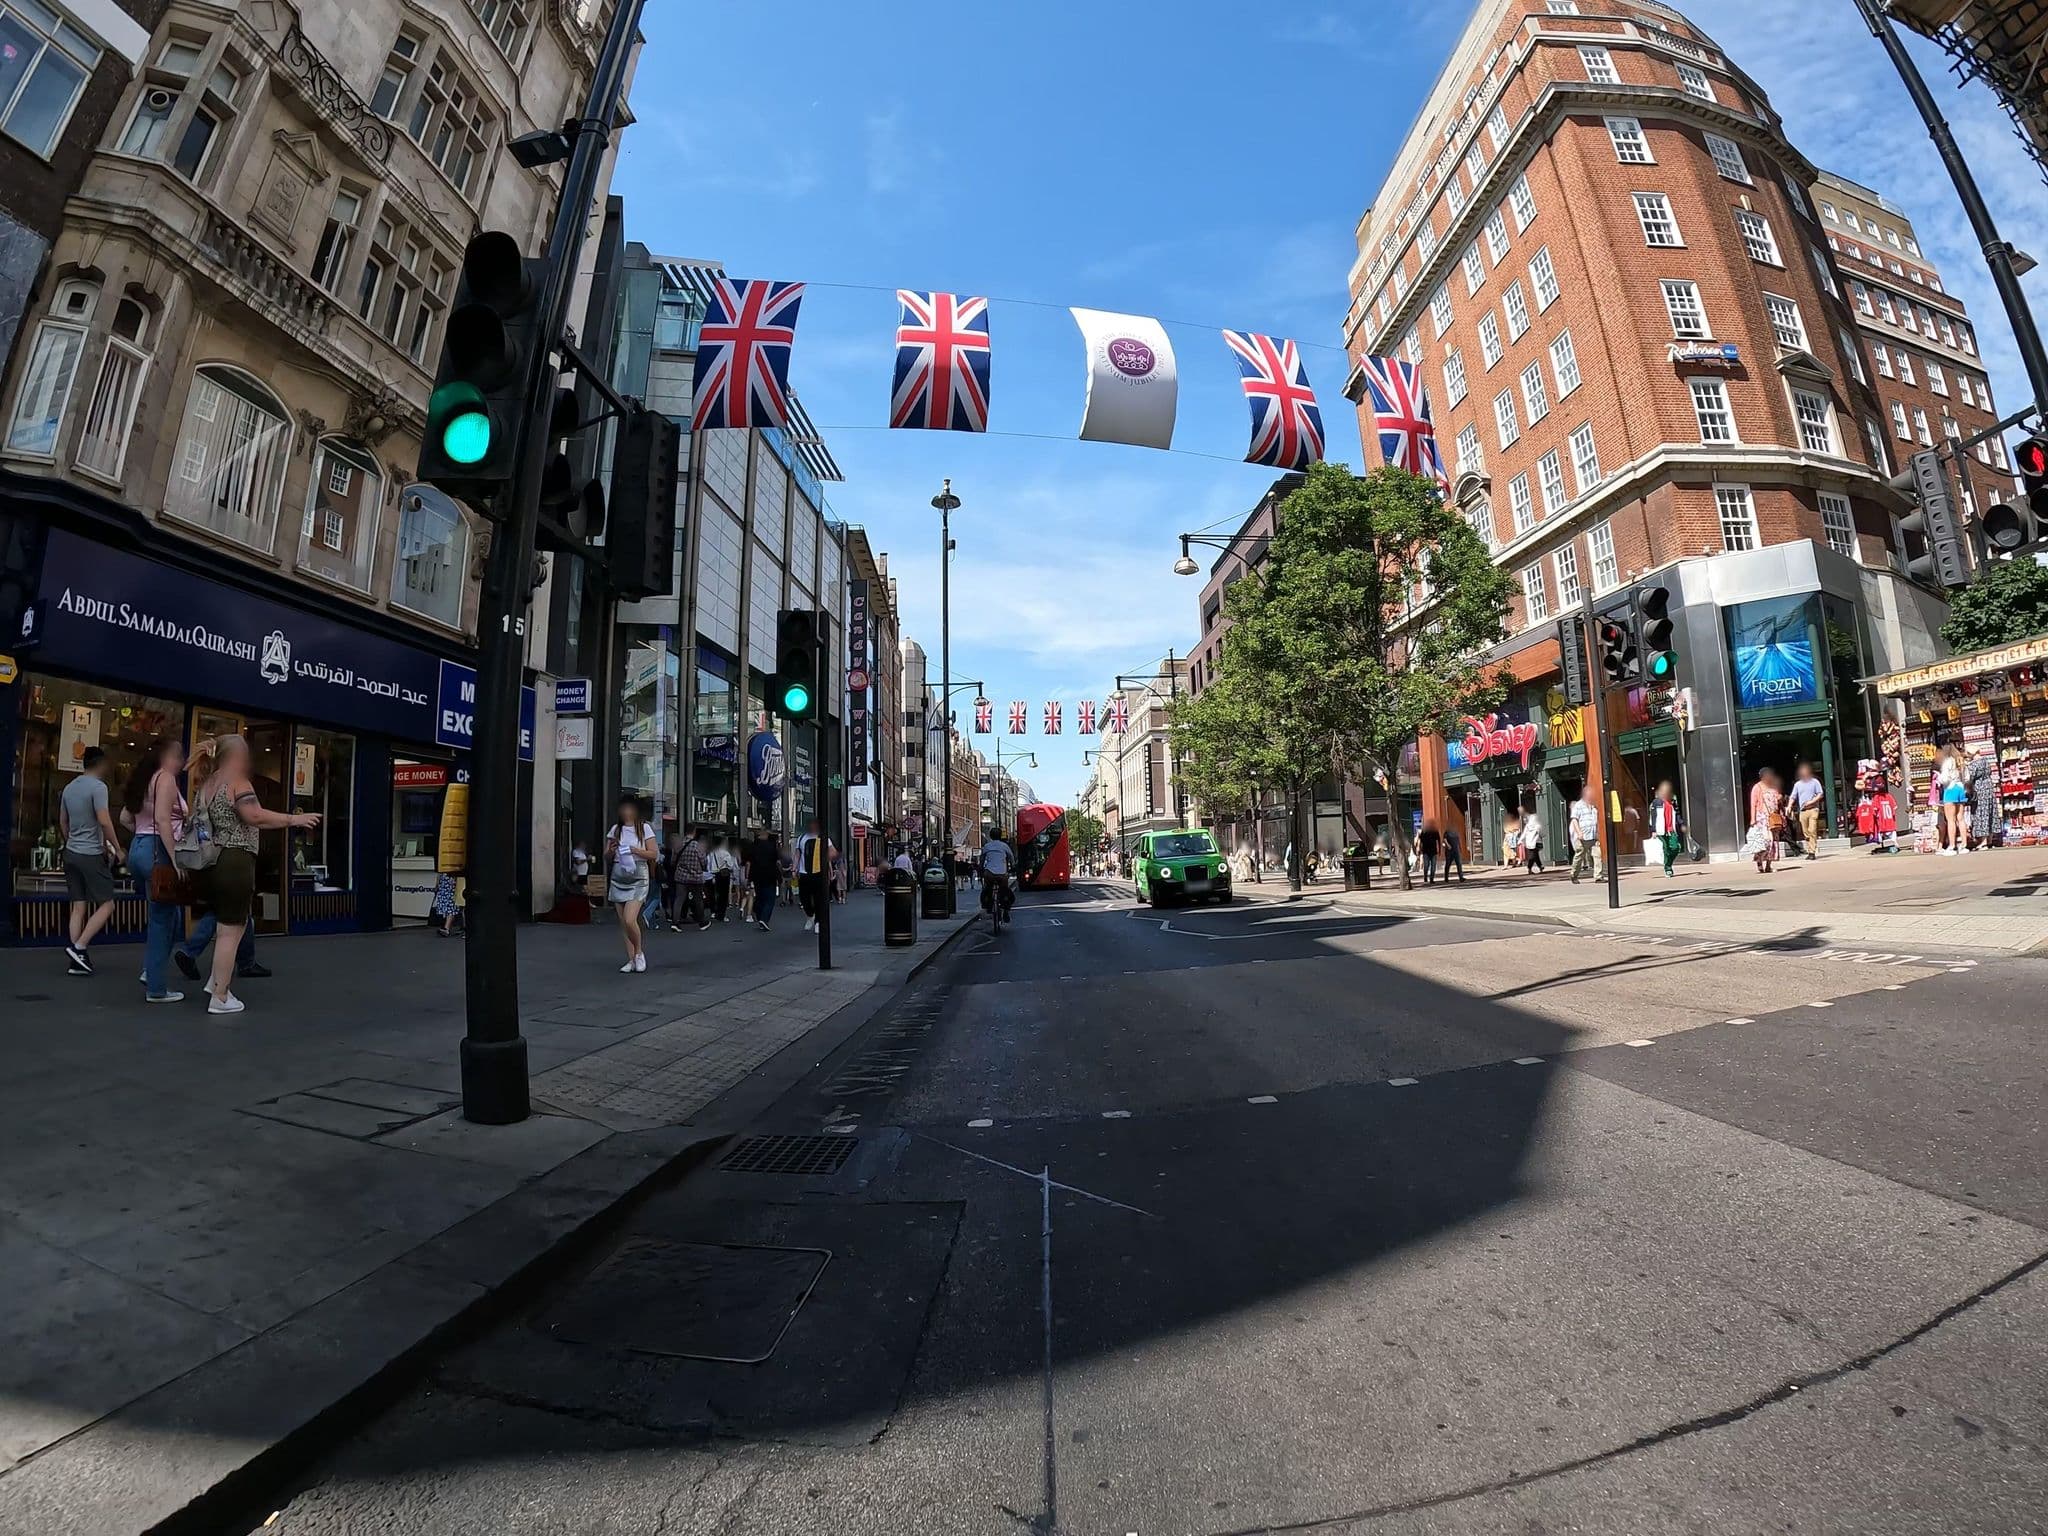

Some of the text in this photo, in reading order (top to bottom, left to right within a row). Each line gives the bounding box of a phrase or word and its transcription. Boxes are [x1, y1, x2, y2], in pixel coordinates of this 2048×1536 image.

[294, 660, 428, 706] عبد الصمد القرشي
[556, 687, 585, 695] MONEY
[1751, 676, 1802, 695] FROZEN
[556, 696, 585, 705] CHANGE
[71, 708, 92, 725] 1+1
[411, 770, 445, 780] MONEY
[1882, 803, 1893, 819] 10
